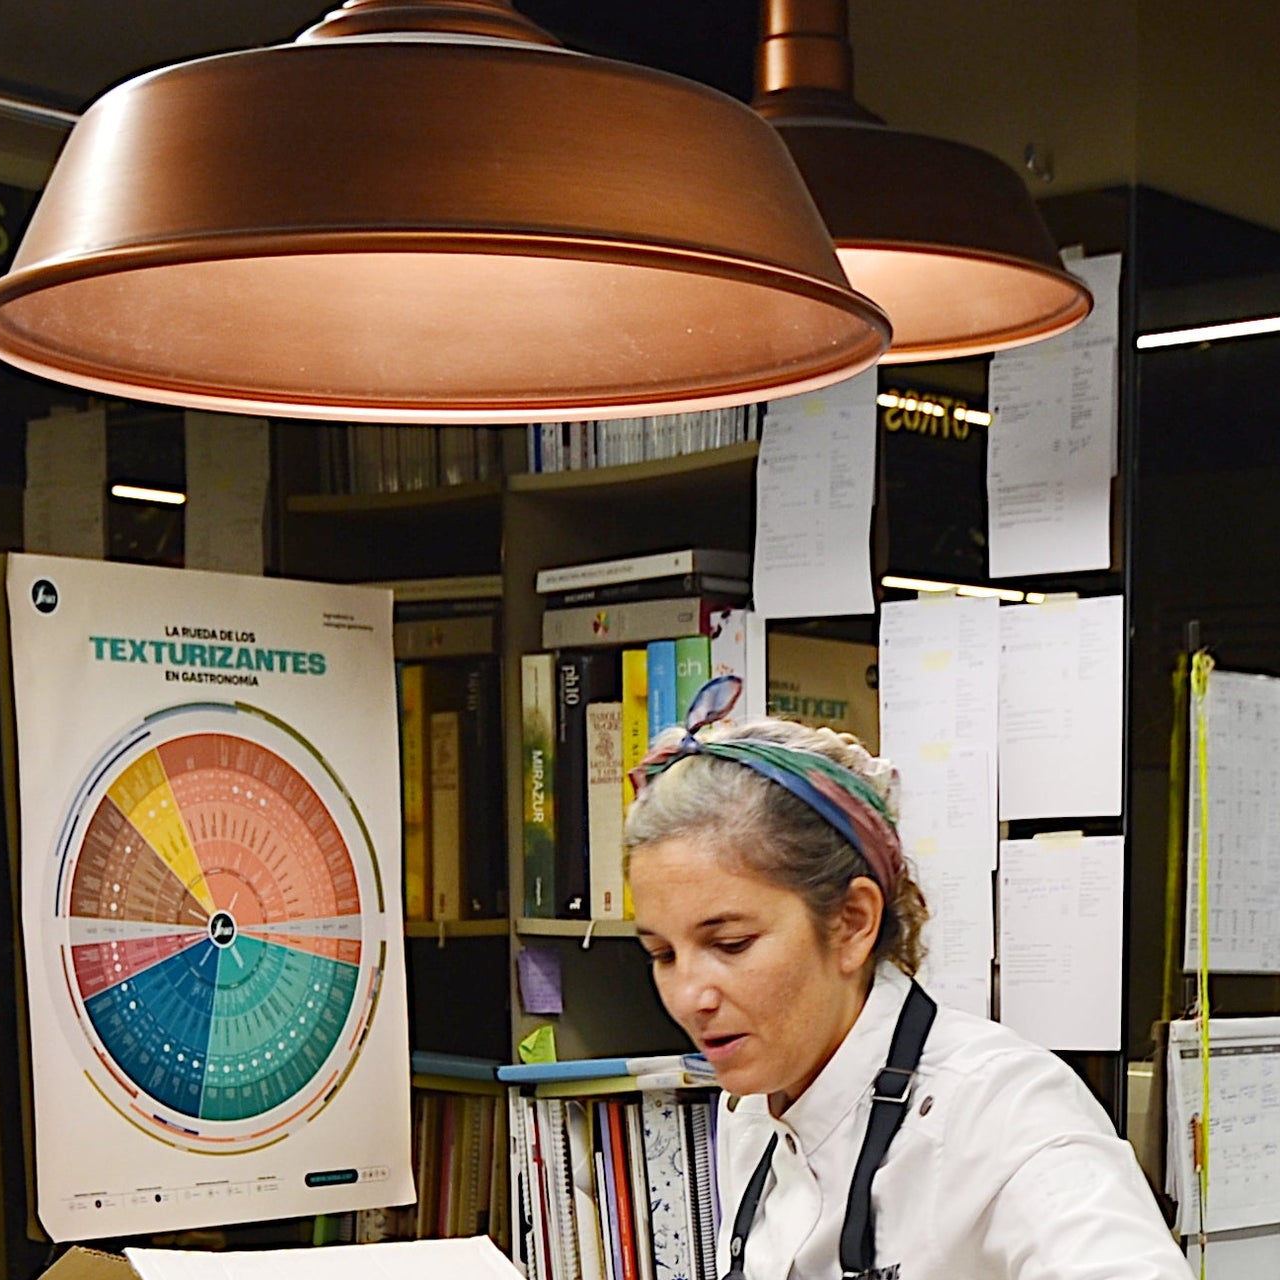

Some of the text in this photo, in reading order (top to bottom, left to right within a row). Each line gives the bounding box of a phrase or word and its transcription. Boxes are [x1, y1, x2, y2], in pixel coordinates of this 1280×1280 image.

[165, 626, 256, 643] LA RUEDA DE LOS
[89, 635, 327, 676] TEXTURIZANTES
[165, 670, 259, 687] EN GASTRONOMÍA
[532, 749, 545, 823] MIRAZUR
